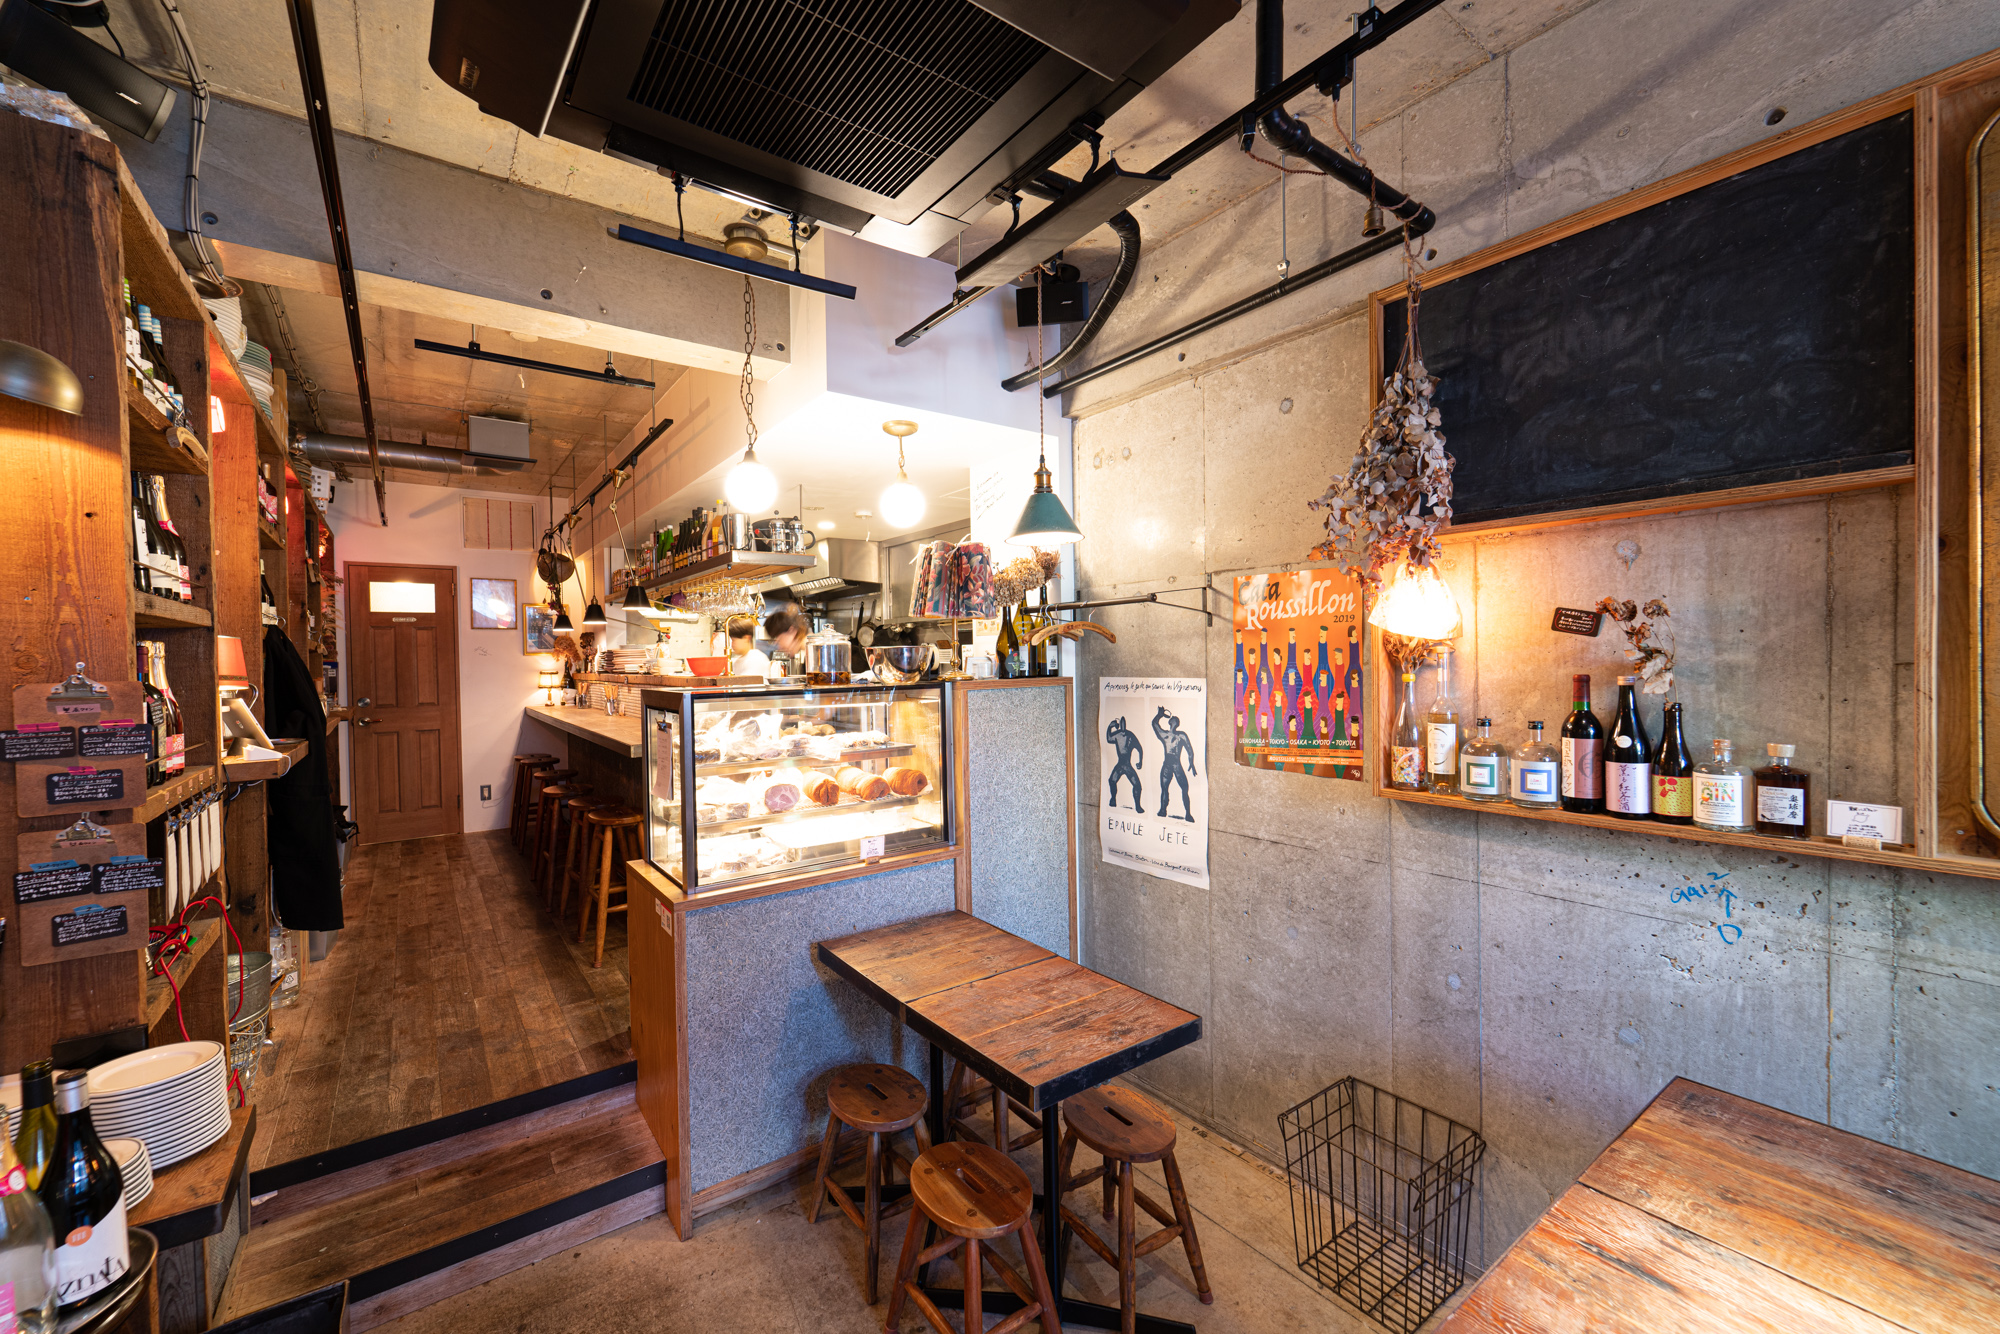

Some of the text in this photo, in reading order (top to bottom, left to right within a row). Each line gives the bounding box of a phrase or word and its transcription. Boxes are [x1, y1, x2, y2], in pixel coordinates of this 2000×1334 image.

[1238, 578, 1281, 606] Cata
[1244, 580, 1356, 631] Roussillon
[1333, 614, 1356, 623] 2019
[1700, 780, 1735, 788] KOMASA
[1700, 787, 1735, 803] GIN
[1107, 816, 1189, 845] ÉPAULÉ JETÉ
